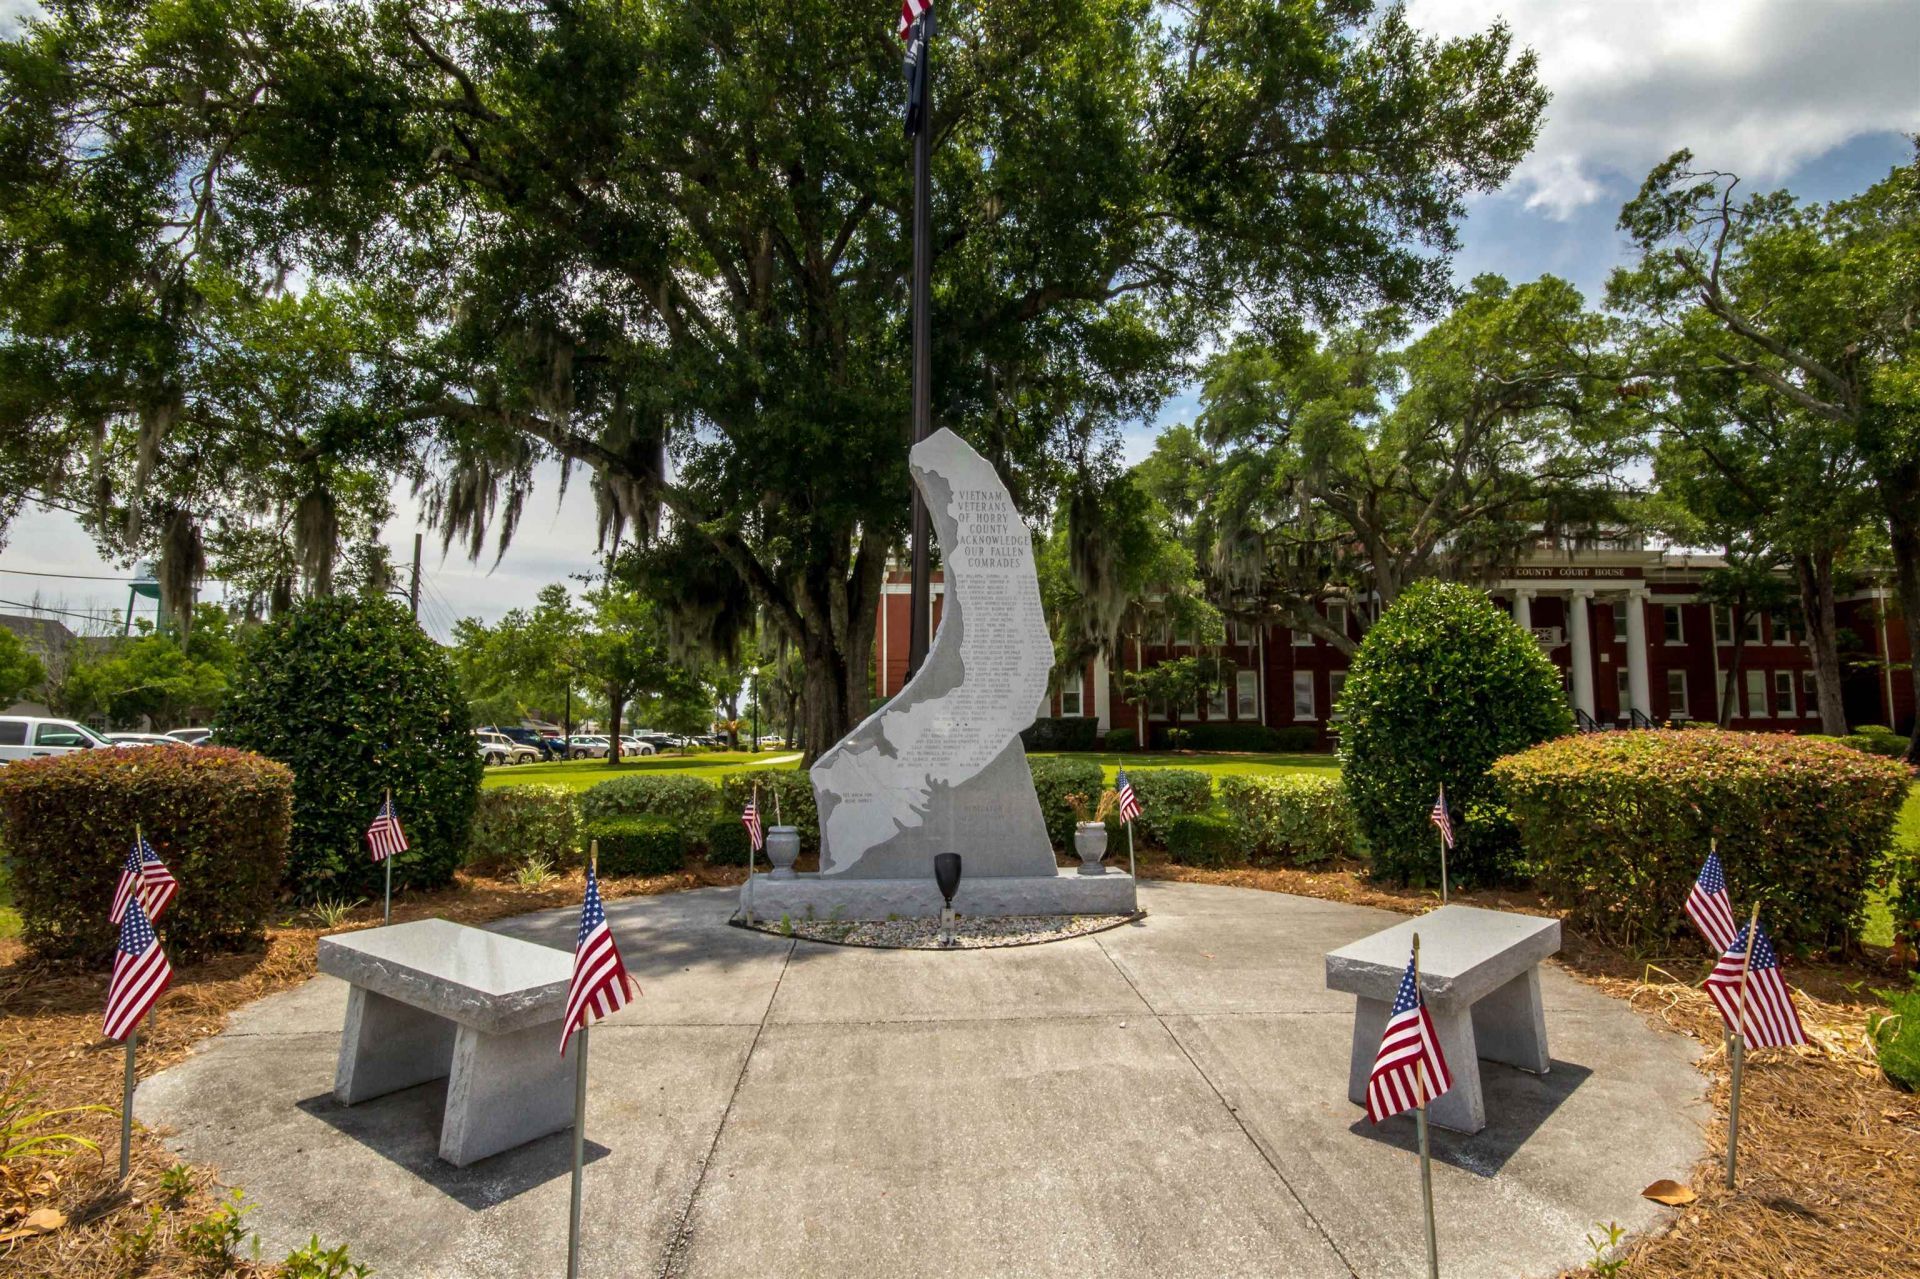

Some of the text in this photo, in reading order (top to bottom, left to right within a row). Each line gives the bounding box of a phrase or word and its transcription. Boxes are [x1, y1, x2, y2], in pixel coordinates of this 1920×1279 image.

[959, 491, 1002, 500] VIETNAM
[958, 502, 1007, 512] VETERANS
[958, 513, 1009, 523] OF HORRY
[969, 524, 1009, 534] COUNTY
[959, 535, 1031, 546] ACKNOWLEDGE
[964, 546, 1024, 556] OUR FALLEN
[968, 558, 1021, 568] COMRADES
[1516, 568, 1554, 576] COUNTY
[1559, 568, 1590, 576] COURT
[1595, 568, 1625, 576] HOUSE
